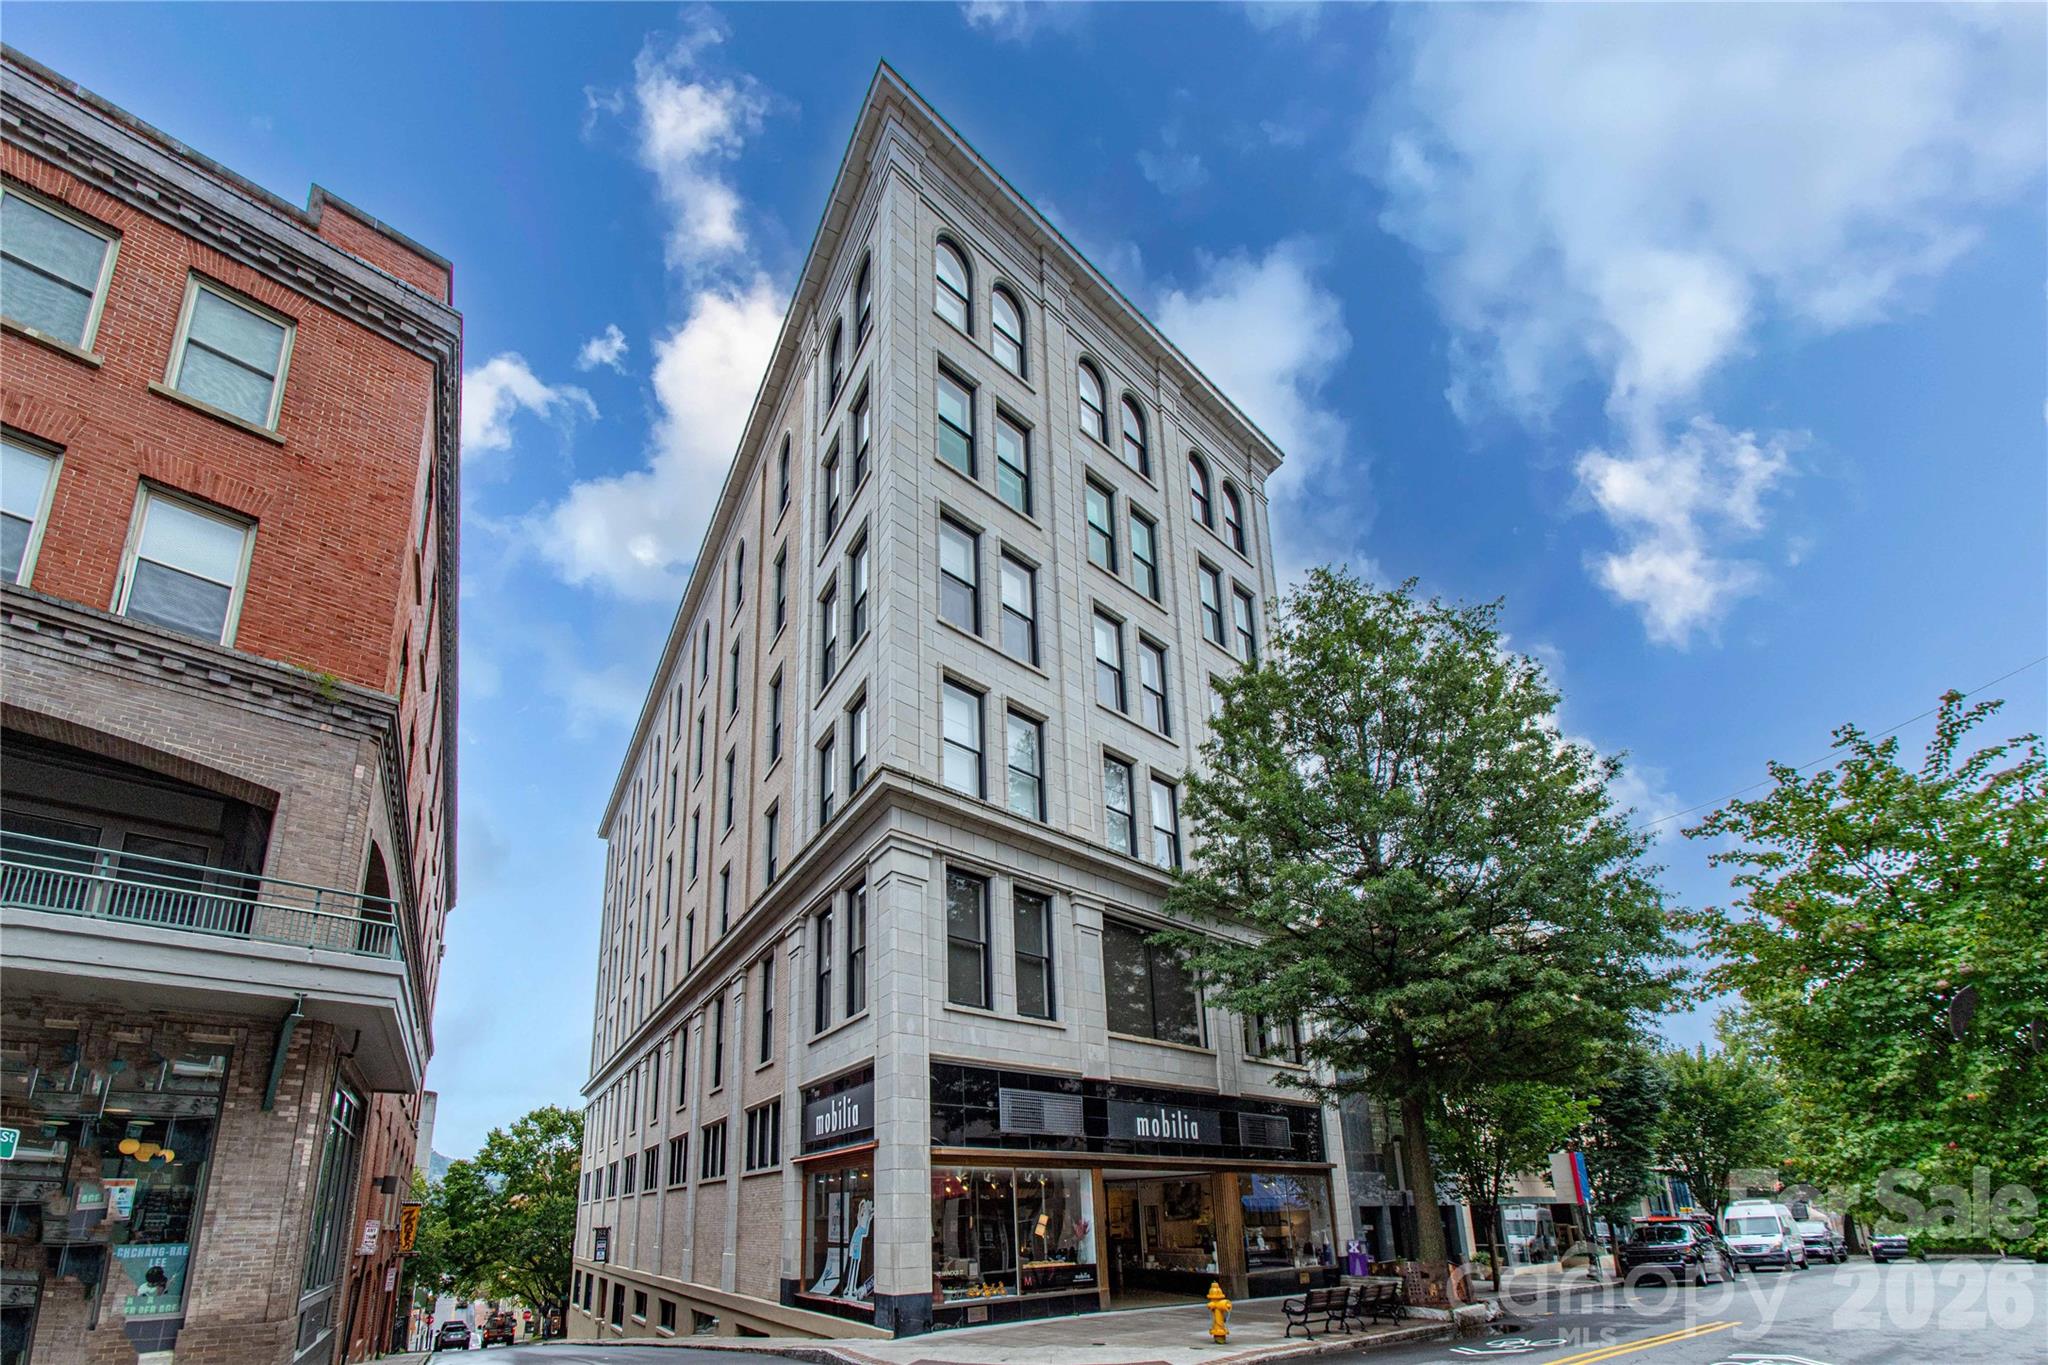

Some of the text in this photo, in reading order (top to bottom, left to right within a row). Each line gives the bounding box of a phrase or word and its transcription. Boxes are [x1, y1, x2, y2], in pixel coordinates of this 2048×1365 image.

[816, 1096, 858, 1135] mobilia
[1137, 1108, 1198, 1139] mobilia
[0, 1131, 15, 1143] St
[148, 1258, 168, 1268] LEE
